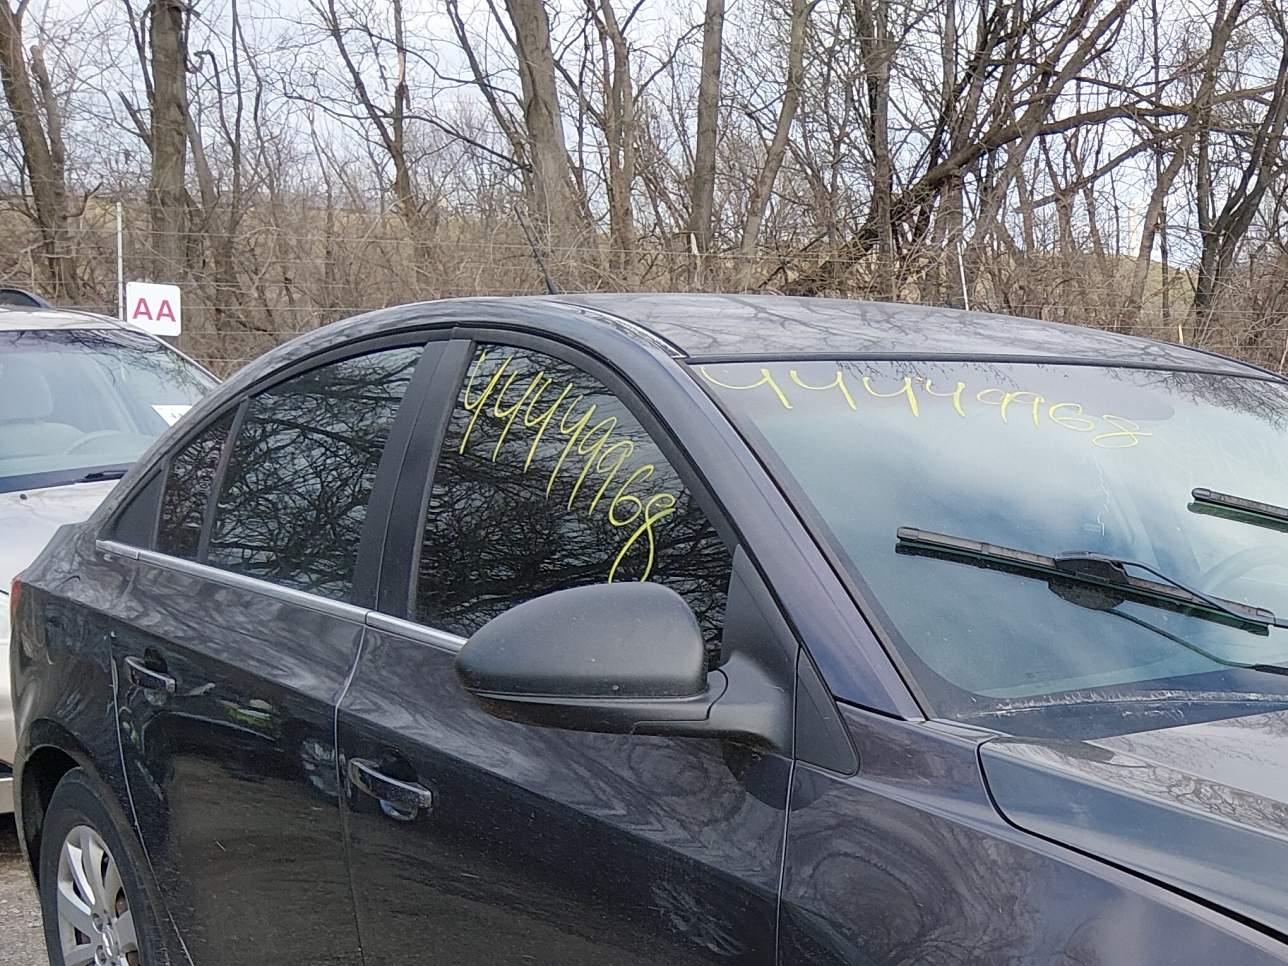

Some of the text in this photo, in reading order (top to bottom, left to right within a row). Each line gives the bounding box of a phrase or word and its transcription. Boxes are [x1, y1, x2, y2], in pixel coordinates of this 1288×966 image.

[132, 297, 177, 322] AA
[701, 366, 1153, 448] 44449968
[459, 349, 677, 584] 44449968
